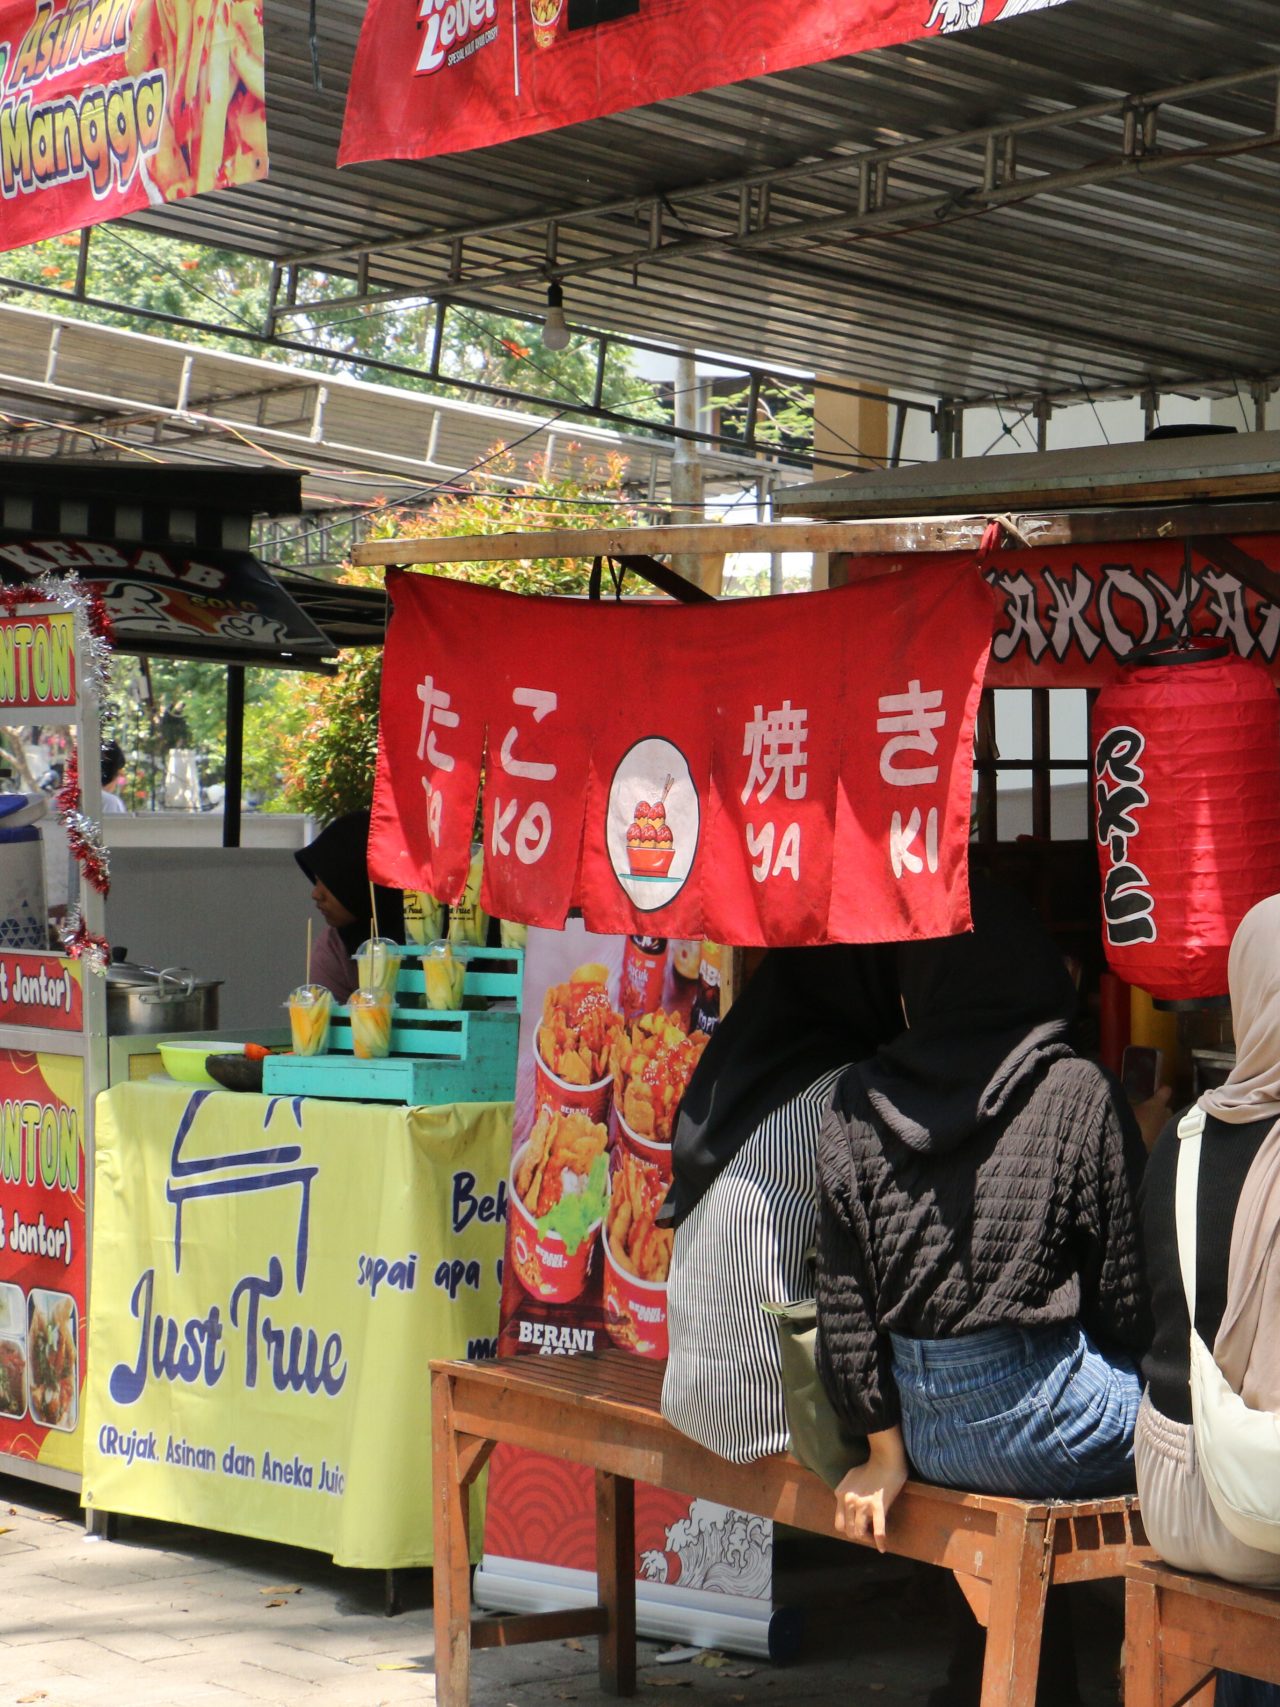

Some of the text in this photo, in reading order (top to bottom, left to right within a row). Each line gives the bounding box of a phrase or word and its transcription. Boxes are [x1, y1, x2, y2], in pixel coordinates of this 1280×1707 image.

[2, 74, 165, 194] Mangga
[3, 541, 225, 589] KEBAB
[492, 797, 552, 864] KO
[746, 821, 800, 883] YA
[890, 806, 938, 879] KI
[0, 1100, 79, 1193] NTON
[434, 1260, 480, 1299] apa
[110, 1257, 348, 1404] Just True
[519, 1320, 595, 1352] BERANI
[165, 1435, 215, 1471] Asinan
[222, 1446, 255, 1478] dan
[262, 1452, 313, 1488] Aneka
